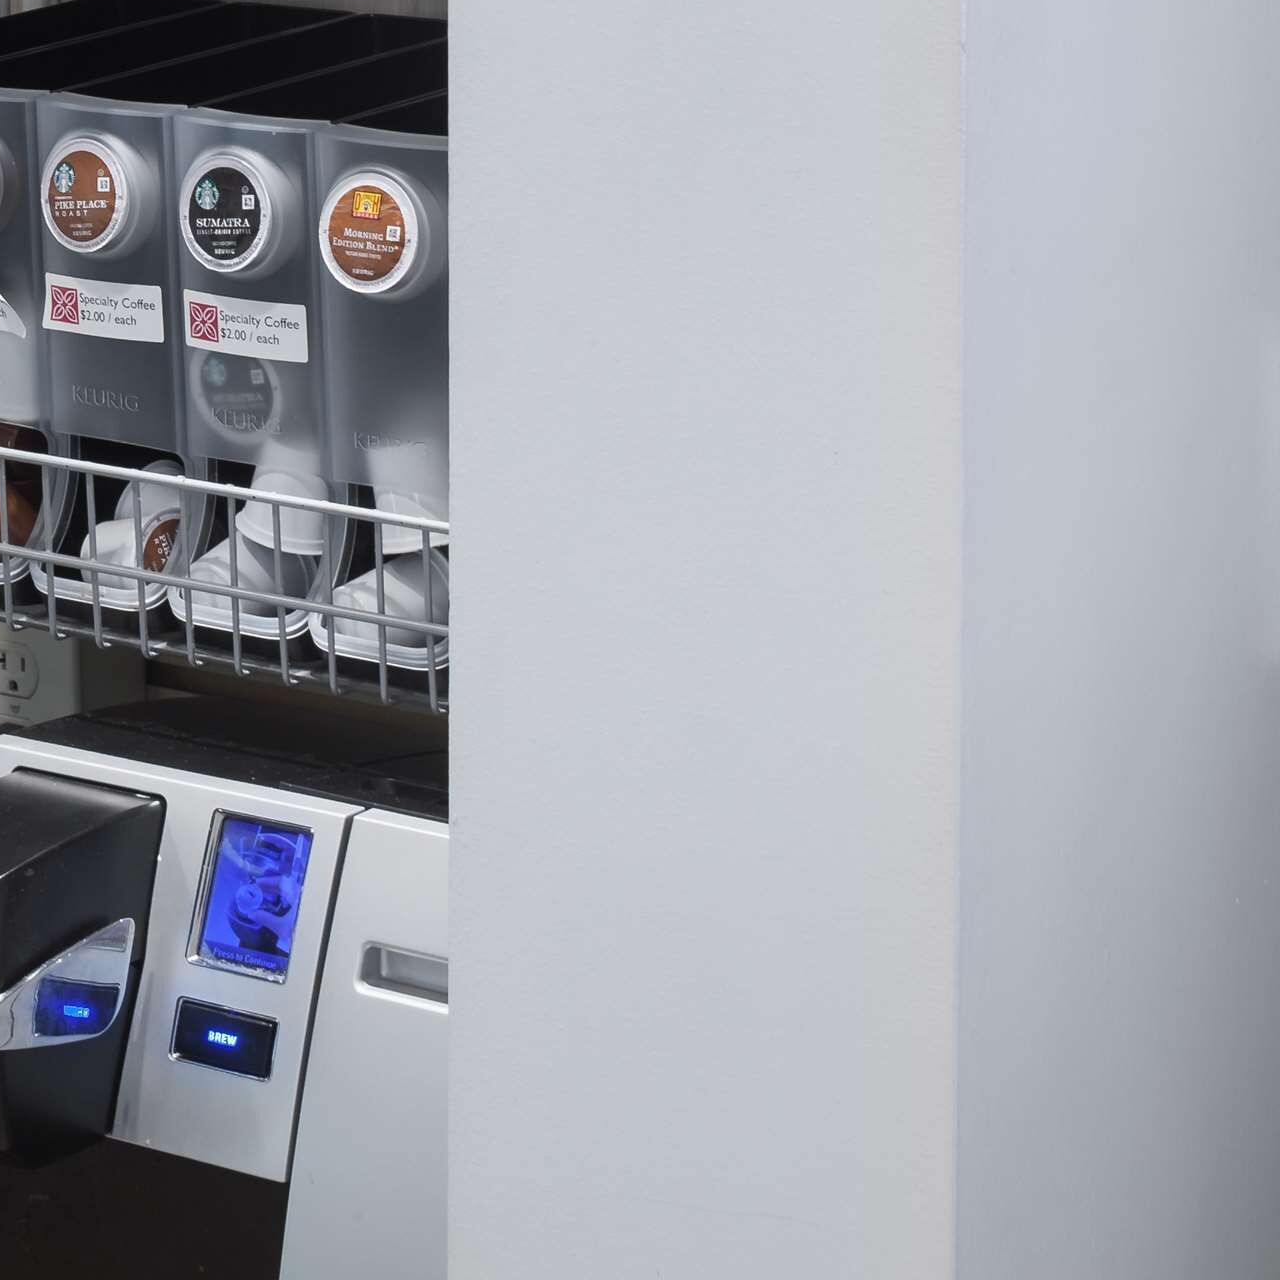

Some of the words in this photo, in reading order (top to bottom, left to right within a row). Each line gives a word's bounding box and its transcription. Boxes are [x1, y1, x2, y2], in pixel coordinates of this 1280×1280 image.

[54, 200, 74, 210] PIKE
[76, 200, 107, 209] PLACE
[196, 218, 250, 228] SUMATRA
[332, 237, 365, 249] EDITION
[344, 228, 384, 241] MORNING
[79, 292, 119, 310] Specialty
[120, 297, 156, 311] Coffee
[80, 308, 105, 323] $2.00
[114, 313, 137, 326] each
[219, 310, 261, 329] Specialty
[264, 315, 300, 331] Coffee
[220, 327, 247, 342] $2.00
[256, 332, 280, 346] each
[72, 384, 140, 411] KEURIG
[213, 947, 235, 960] Press
[244, 952, 277, 968] Continue
[208, 1030, 237, 1047] BREW
